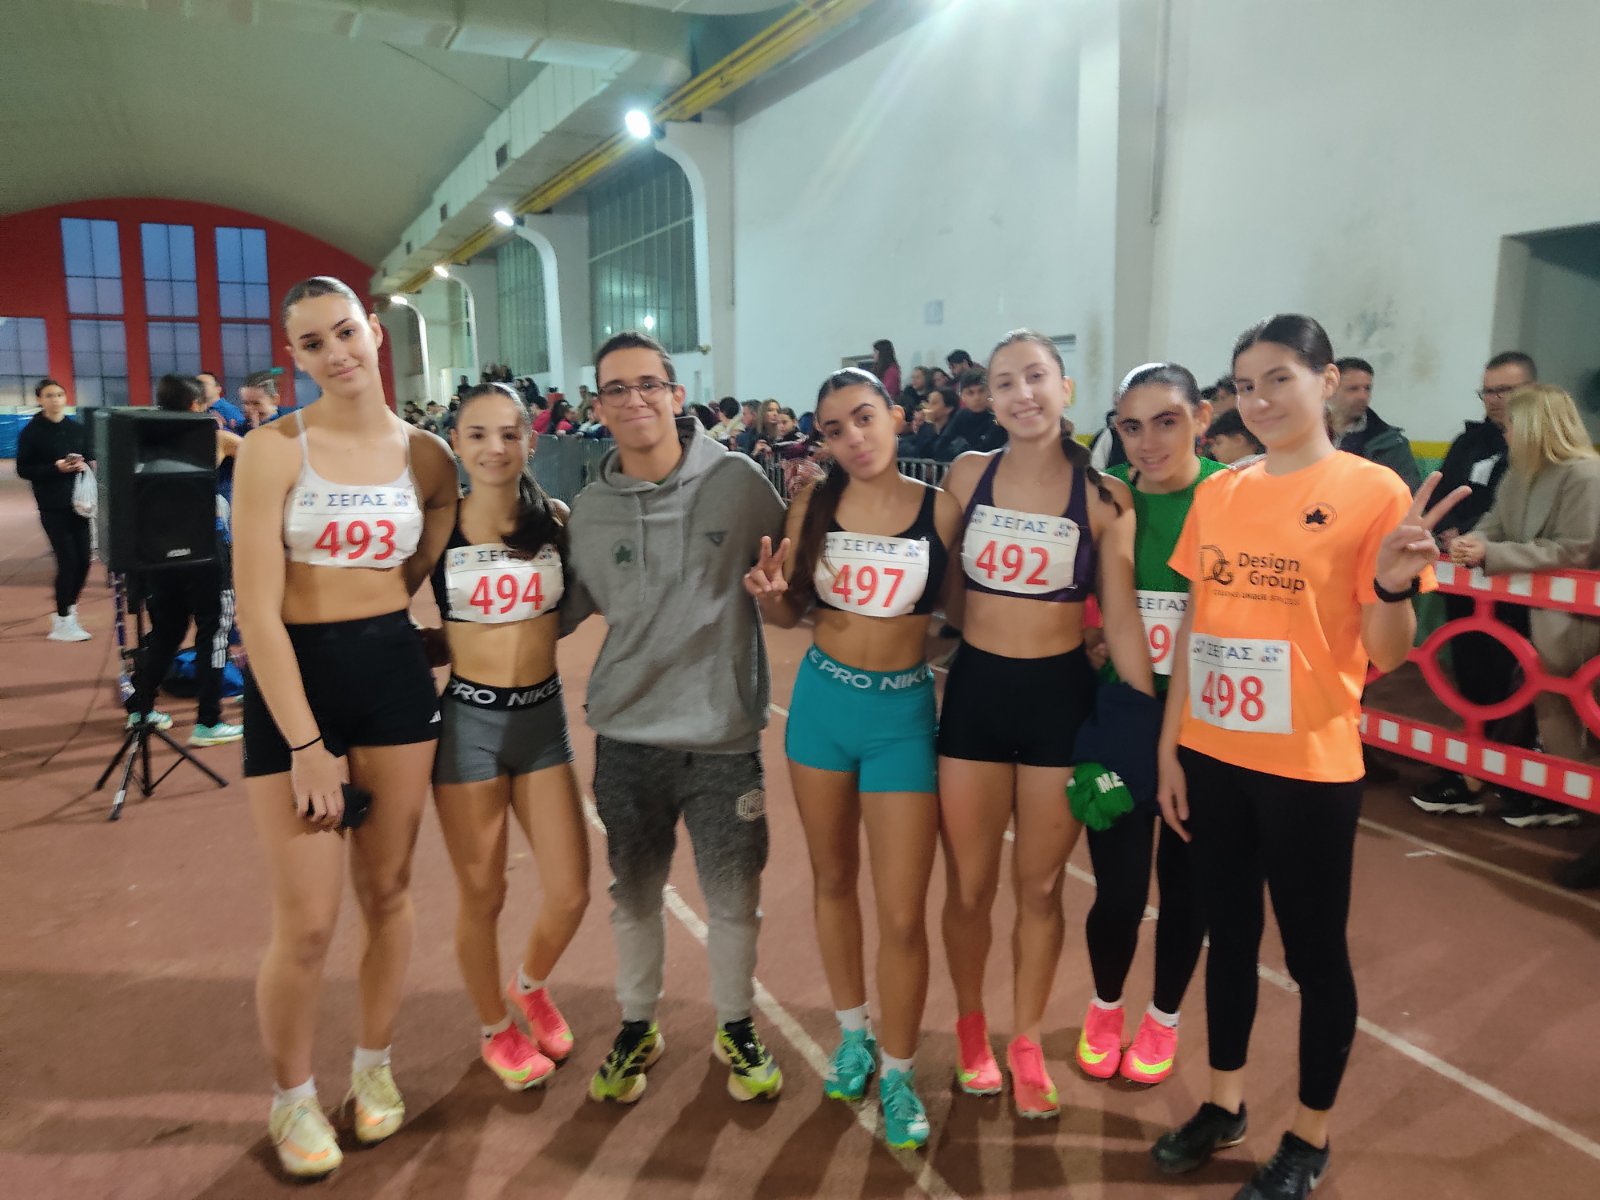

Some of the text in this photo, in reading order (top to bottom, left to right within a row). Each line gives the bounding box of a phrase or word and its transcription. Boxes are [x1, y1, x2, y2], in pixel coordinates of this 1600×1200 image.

[327, 493, 388, 507] ΣΕΓΑΣ
[991, 514, 1049, 534] ΣΕΓΑΣ
[314, 519, 396, 561] 493
[842, 538, 899, 555] ΣΕΓΑΣ
[476, 549, 510, 563] ΣΕΓ
[975, 540, 1050, 586] 492
[1238, 551, 1301, 574] Design
[469, 571, 545, 616] 494
[831, 564, 906, 609] 497
[1249, 570, 1306, 595] Group
[818, 659, 872, 689] PRO
[506, 678, 560, 707] NIKE
[1202, 670, 1265, 722] 498
